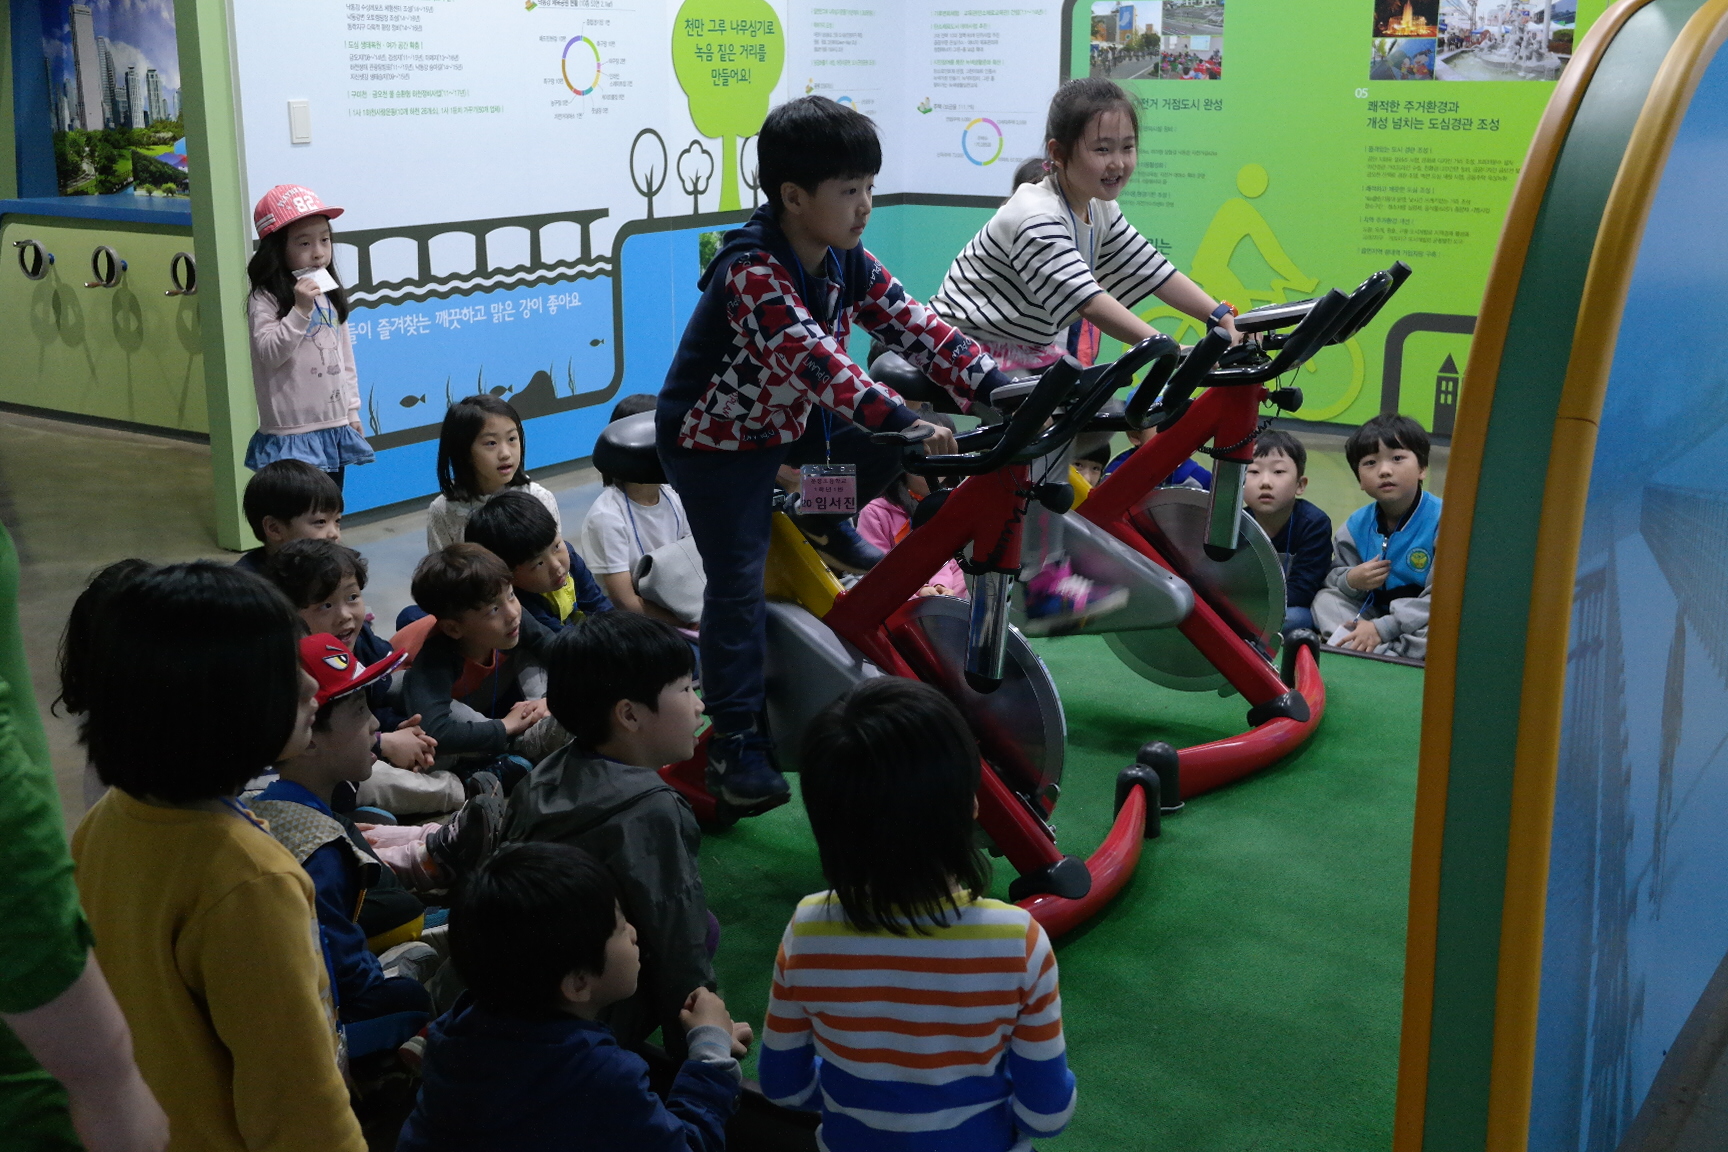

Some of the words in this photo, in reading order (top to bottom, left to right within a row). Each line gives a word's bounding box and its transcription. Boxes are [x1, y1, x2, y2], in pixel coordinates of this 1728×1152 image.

[684, 18, 705, 38] 천만
[708, 19, 727, 36] 그루
[730, 19, 776, 38] 나무심기로
[694, 43, 714, 62] 녹음
[717, 43, 738, 62] 짙은
[740, 43, 768, 63] 거리를
[711, 68, 752, 86] 만들어요!
[1354, 88, 1368, 99] 05
[1141, 98, 1158, 110] 전거
[1162, 98, 1200, 111] 거점도시
[1203, 98, 1223, 111] 완성
[1367, 100, 1400, 114] 쾌적한
[1404, 100, 1460, 114] 주거환경과
[1366, 117, 1388, 130] 개성
[1392, 117, 1425, 130] 넘치는
[1428, 118, 1474, 131] 도심경관
[1477, 118, 1500, 132] 조성
[292, 196, 318, 212] 82
[376, 313, 432, 340] 즐겨찾는
[434, 304, 488, 330] 깨끗하고
[490, 300, 516, 324] 맑은
[519, 296, 543, 319] 강이
[546, 292, 583, 316] 좋아요
[815, 496, 855, 510] 임서진
